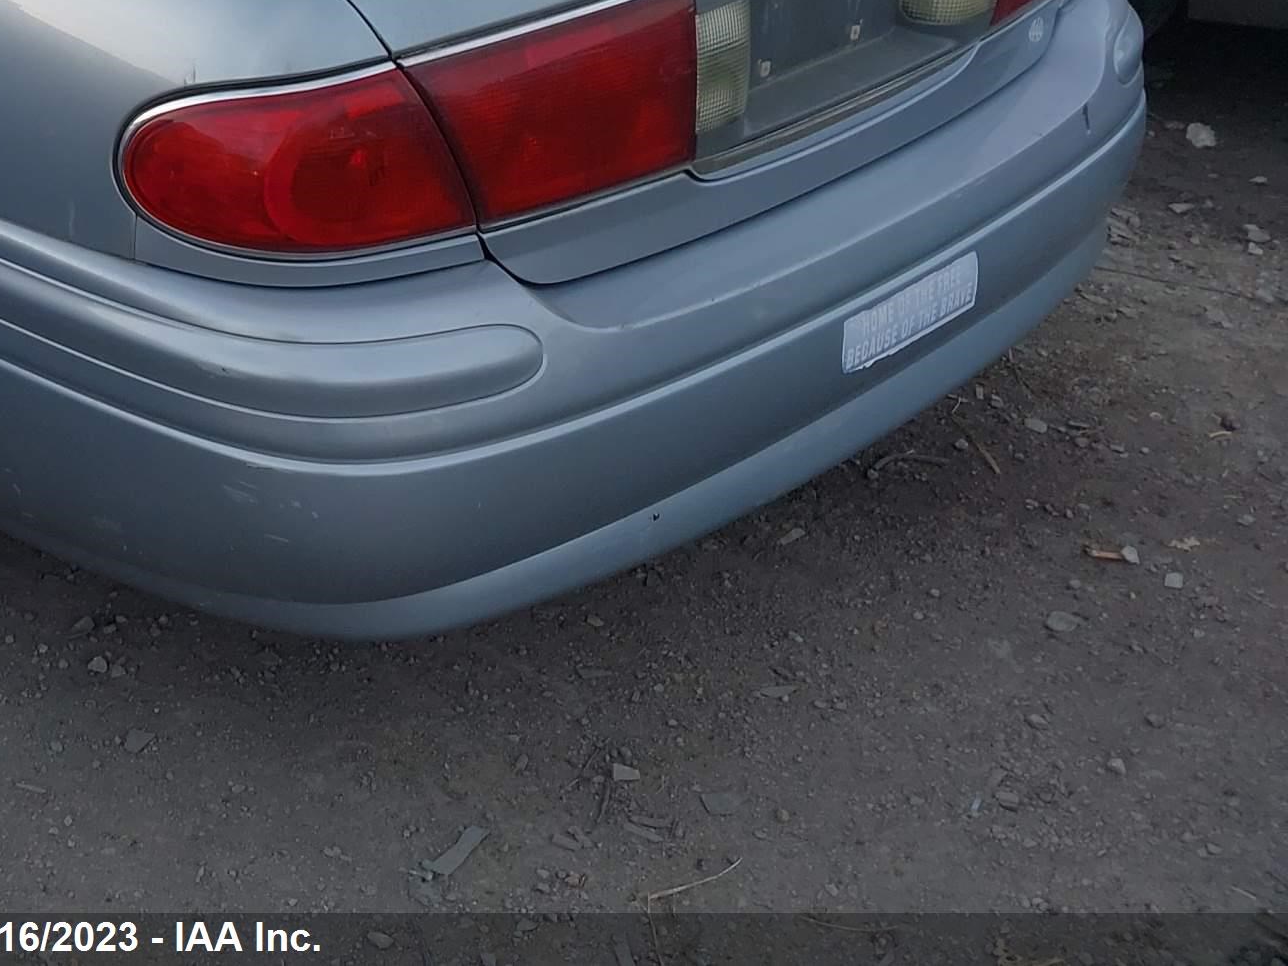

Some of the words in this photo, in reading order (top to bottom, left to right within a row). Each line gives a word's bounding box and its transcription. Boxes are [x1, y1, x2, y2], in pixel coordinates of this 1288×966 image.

[845, 324, 899, 371] BECAUSE
[901, 314, 916, 339] OF
[919, 302, 938, 329] THE
[940, 281, 972, 318] BRAVE
[863, 301, 894, 335] HOME
[915, 279, 936, 308] THE
[937, 264, 961, 296] FREE
